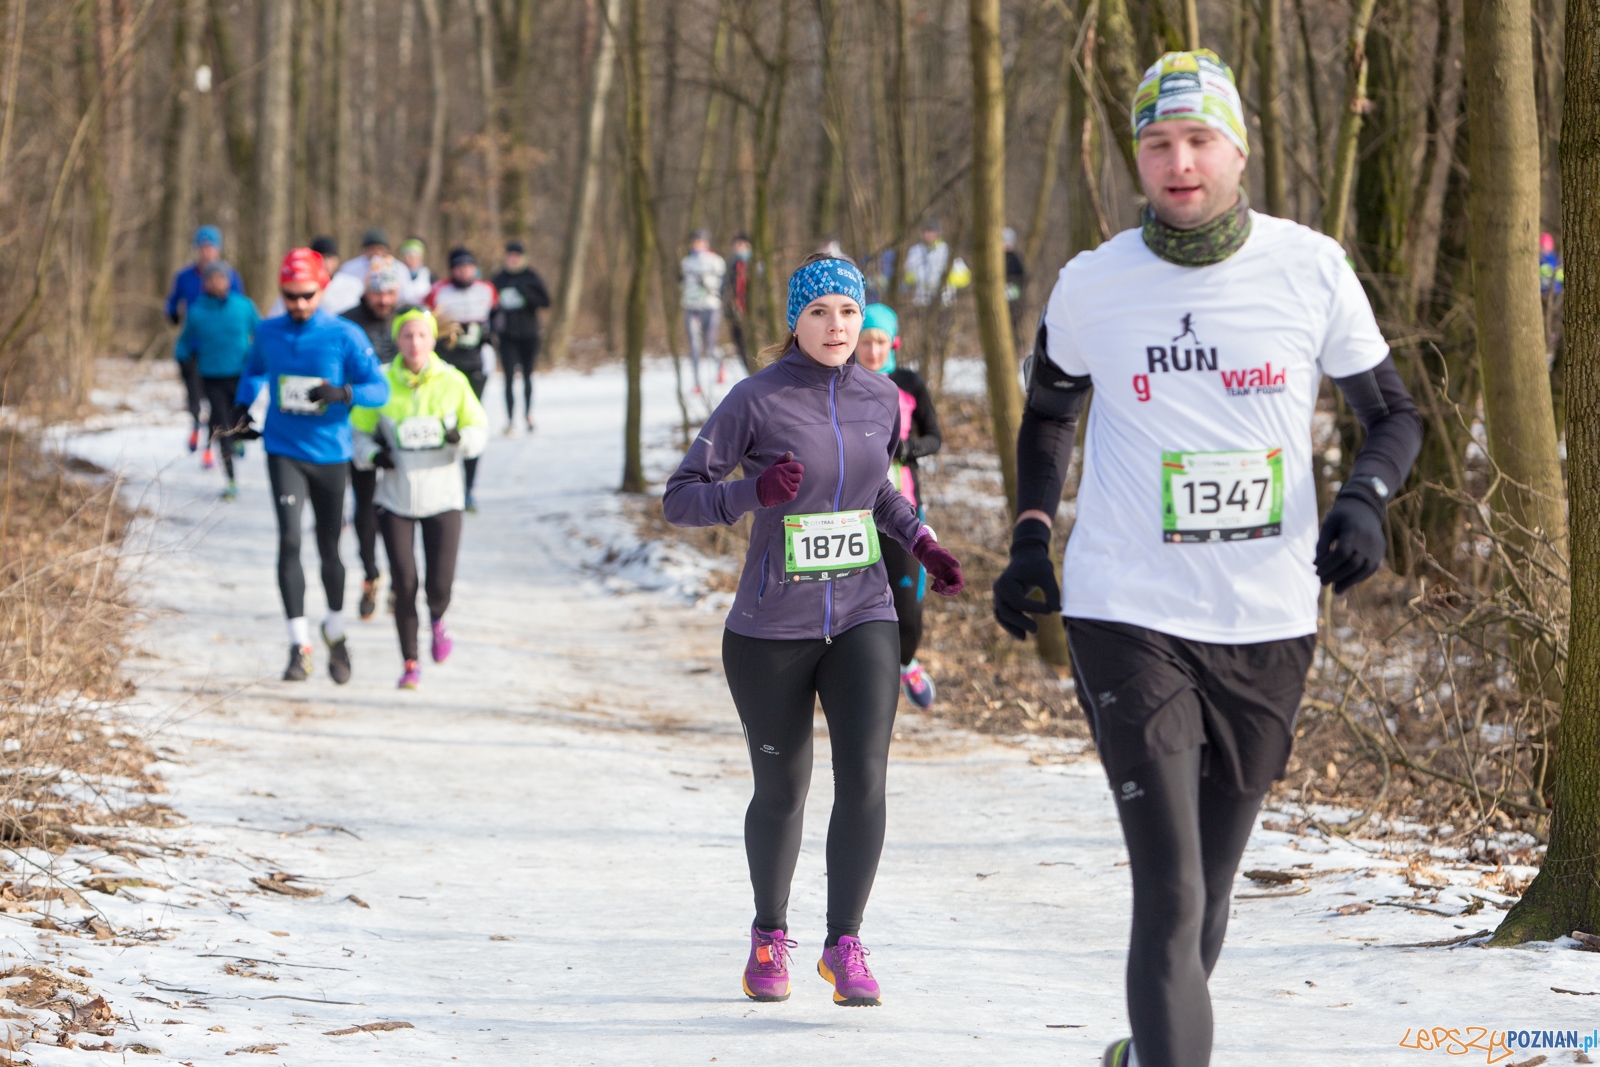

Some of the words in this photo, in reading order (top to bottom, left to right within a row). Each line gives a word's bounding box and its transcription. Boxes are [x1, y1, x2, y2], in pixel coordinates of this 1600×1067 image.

[1147, 345, 1218, 373] RUN
[1226, 387, 1250, 396] TEAM
[1182, 478, 1269, 514] 1347
[801, 533, 863, 559] 1876
